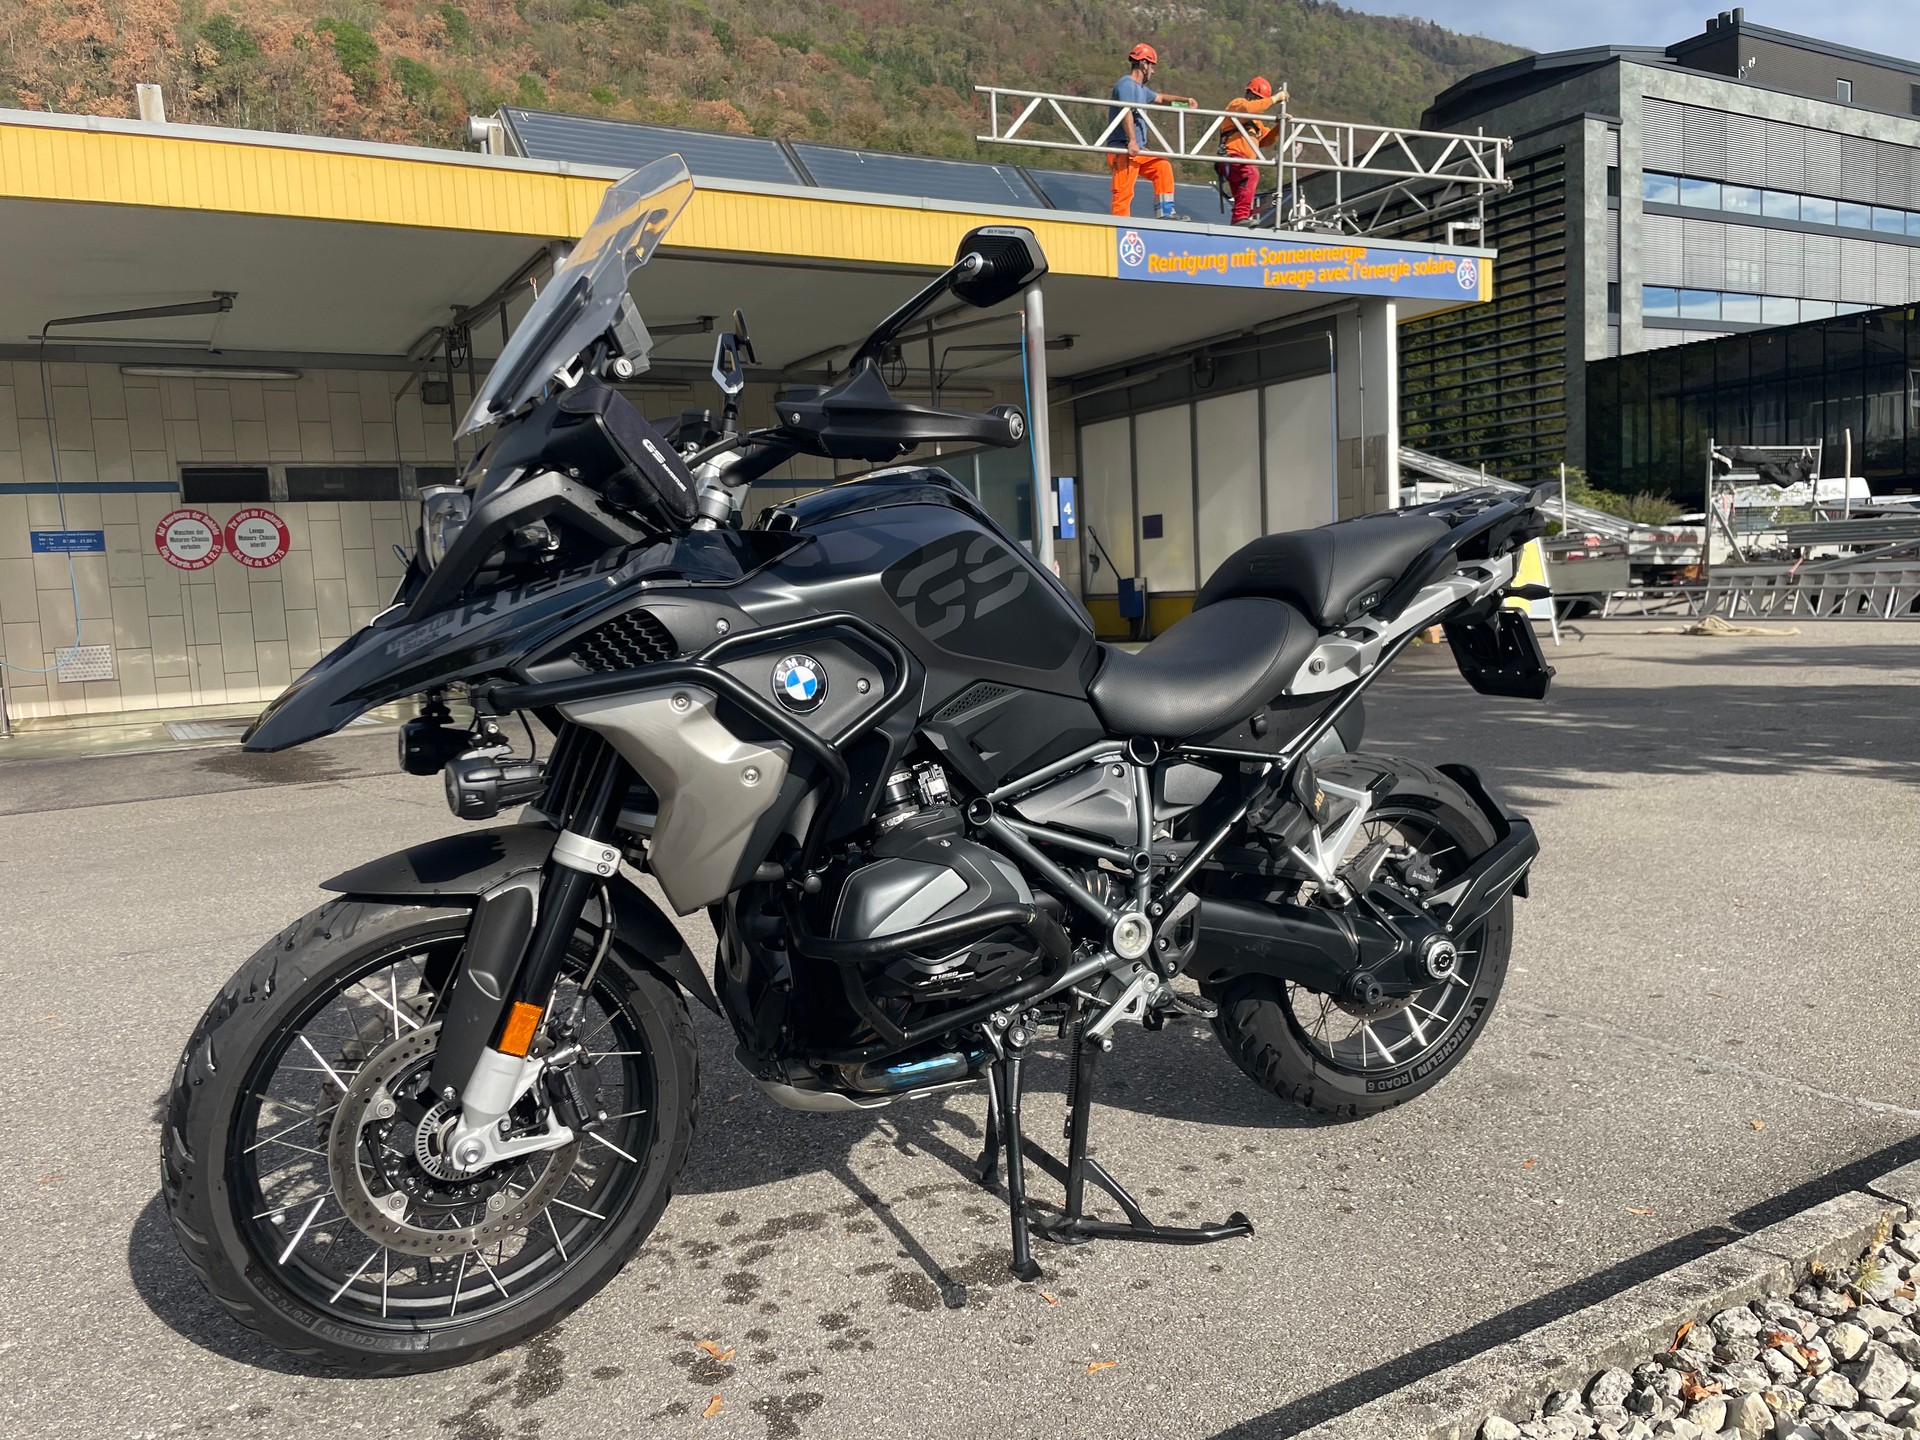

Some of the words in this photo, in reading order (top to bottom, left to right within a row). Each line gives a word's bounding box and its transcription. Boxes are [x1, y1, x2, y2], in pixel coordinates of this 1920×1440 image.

[1148, 251, 1229, 276] Reinigung
[1231, 247, 1257, 268] mit
[1259, 246, 1367, 266] Sonnenenergie
[1264, 268, 1315, 289] Lavage
[1318, 265, 1350, 283] avec
[1352, 259, 1411, 282] l'énergie
[1413, 256, 1457, 276] solaire
[1063, 502, 1072, 515] 4
[896, 534, 1030, 641] GS
[775, 657, 817, 682] BMW
[1416, 1019, 1473, 1077] MICHELIN
[1367, 1081, 1375, 1091] 6
[1377, 1074, 1410, 1091] ROAD
[277, 1299, 313, 1325] 120/70
